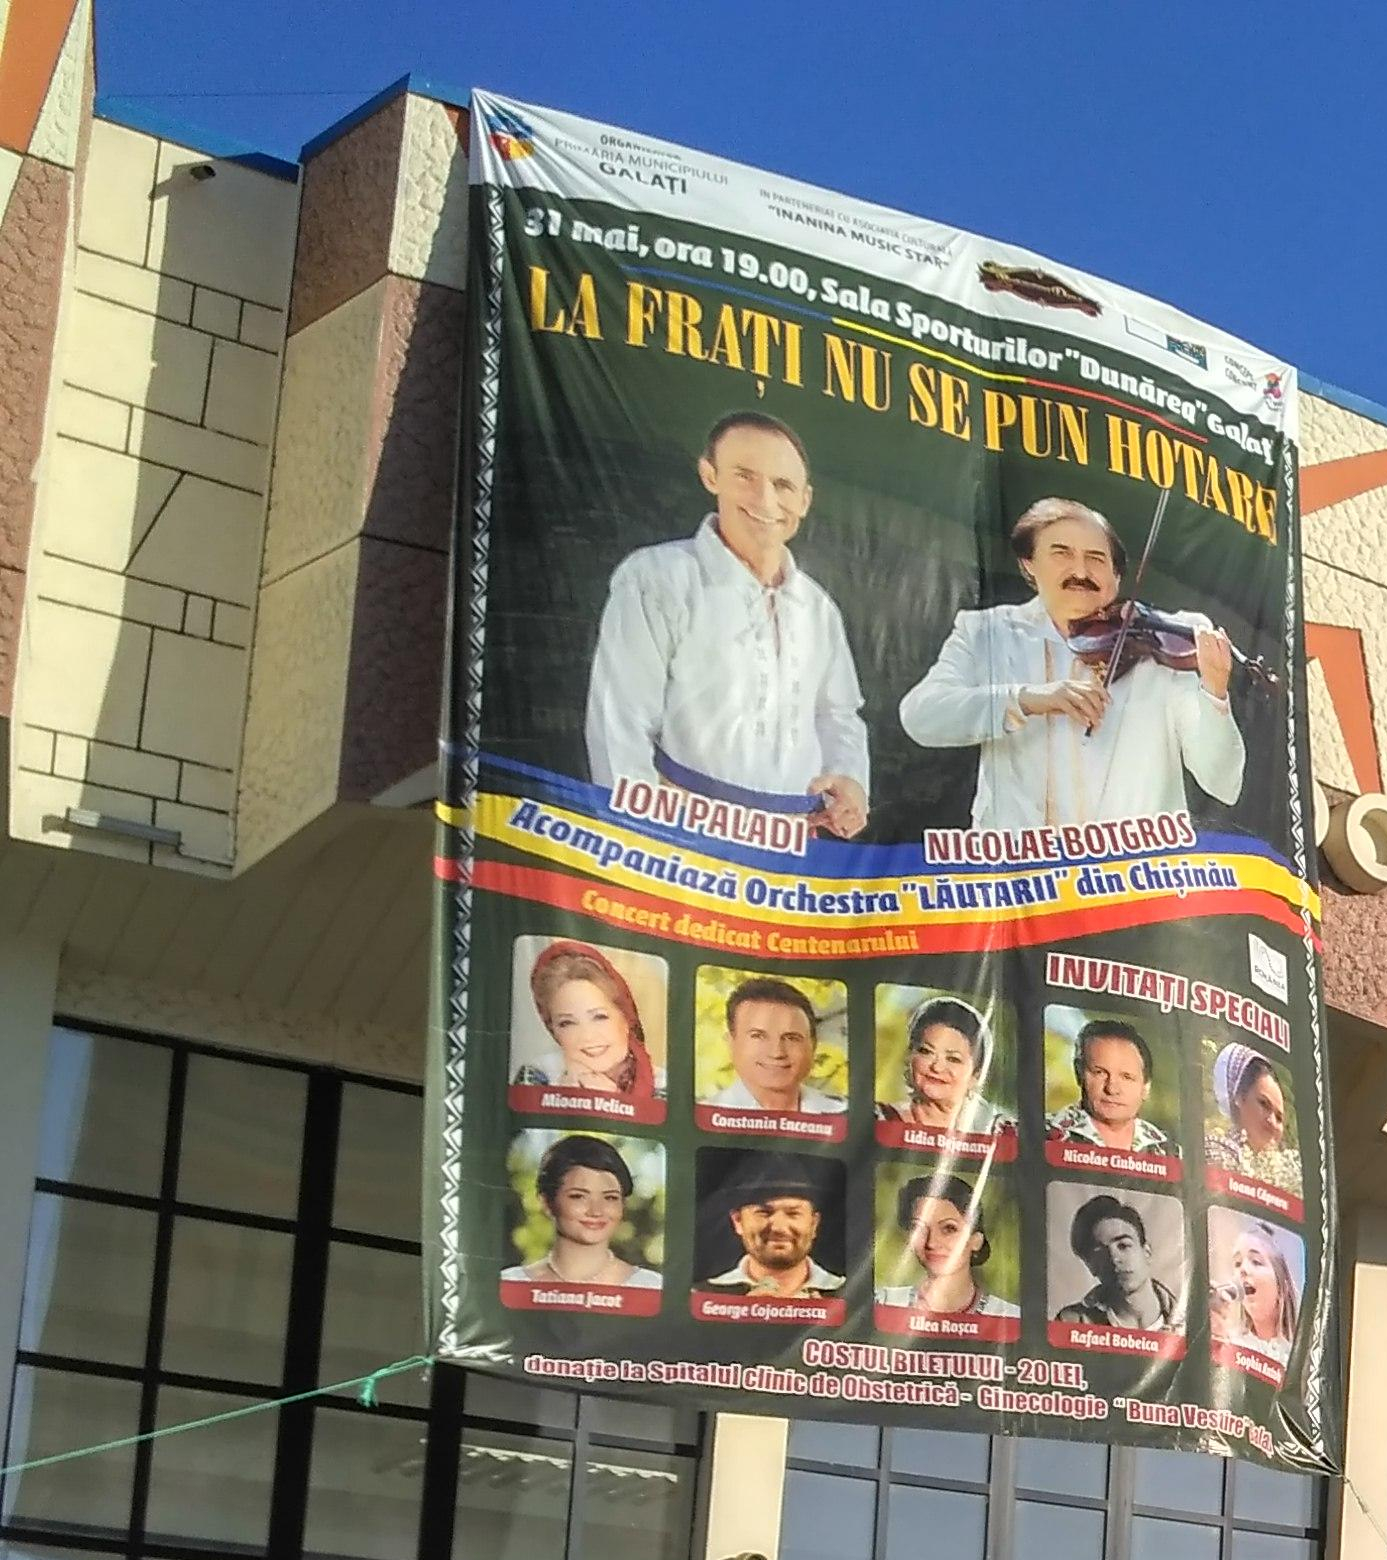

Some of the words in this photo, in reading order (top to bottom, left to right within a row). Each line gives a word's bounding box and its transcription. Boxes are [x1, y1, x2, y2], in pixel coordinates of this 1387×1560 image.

[850, 231, 901, 255] MUSIC
[523, 206, 562, 237] 31
[571, 214, 648, 259] mai,
[653, 235, 713, 270] ora
[721, 246, 817, 302] 19.00,
[820, 277, 892, 322] Sala
[895, 300, 1063, 372] Sporturilor
[528, 266, 605, 341] LA
[625, 280, 805, 399] FRAȚI
[822, 333, 892, 413] NU
[909, 362, 972, 442] SE
[983, 388, 1090, 466] PUN
[1105, 412, 1278, 547] HOTARE
[612, 776, 686, 828] ION
[688, 799, 808, 855] PALADI
[925, 827, 1056, 864] NICOLAE
[1061, 811, 1195, 858] BOTGROS
[511, 801, 738, 899] Acompaniază
[744, 877, 900, 916] Orchestra
[901, 867, 1068, 912] "LĂUTARII"
[1076, 868, 1127, 897] din
[1129, 859, 1239, 899] Chișinău
[581, 889, 670, 932] Concert
[673, 913, 763, 949] dedicat
[766, 928, 920, 956] Centenarului
[1047, 953, 1188, 1013] INVITAȚI
[1191, 982, 1291, 1053] SPECIALI
[541, 1092, 593, 1112] Mioara
[594, 1097, 635, 1117] Velicu
[903, 1129, 936, 1147] Lidia
[1063, 1149, 1109, 1169] Nicolae
[1110, 1153, 1168, 1177] Ciubotaru
[702, 1300, 749, 1320] George
[941, 1320, 979, 1337] Roșca
[804, 1339, 889, 1372] COSTUL
[894, 1350, 1004, 1381] BILETULUI
[1018, 1359, 1051, 1384] 20
[1051, 1363, 1088, 1391] LEI,
[1070, 1329, 1111, 1349] Rafael
[1112, 1335, 1160, 1353] Bobeica
[524, 1354, 620, 1383] donație
[620, 1360, 647, 1382] la
[648, 1361, 742, 1389] Spitalul
[743, 1368, 806, 1395] clinic
[809, 1372, 840, 1396] de
[843, 1377, 960, 1407] Obstetrică
[977, 1387, 1110, 1419] Ginecologie
